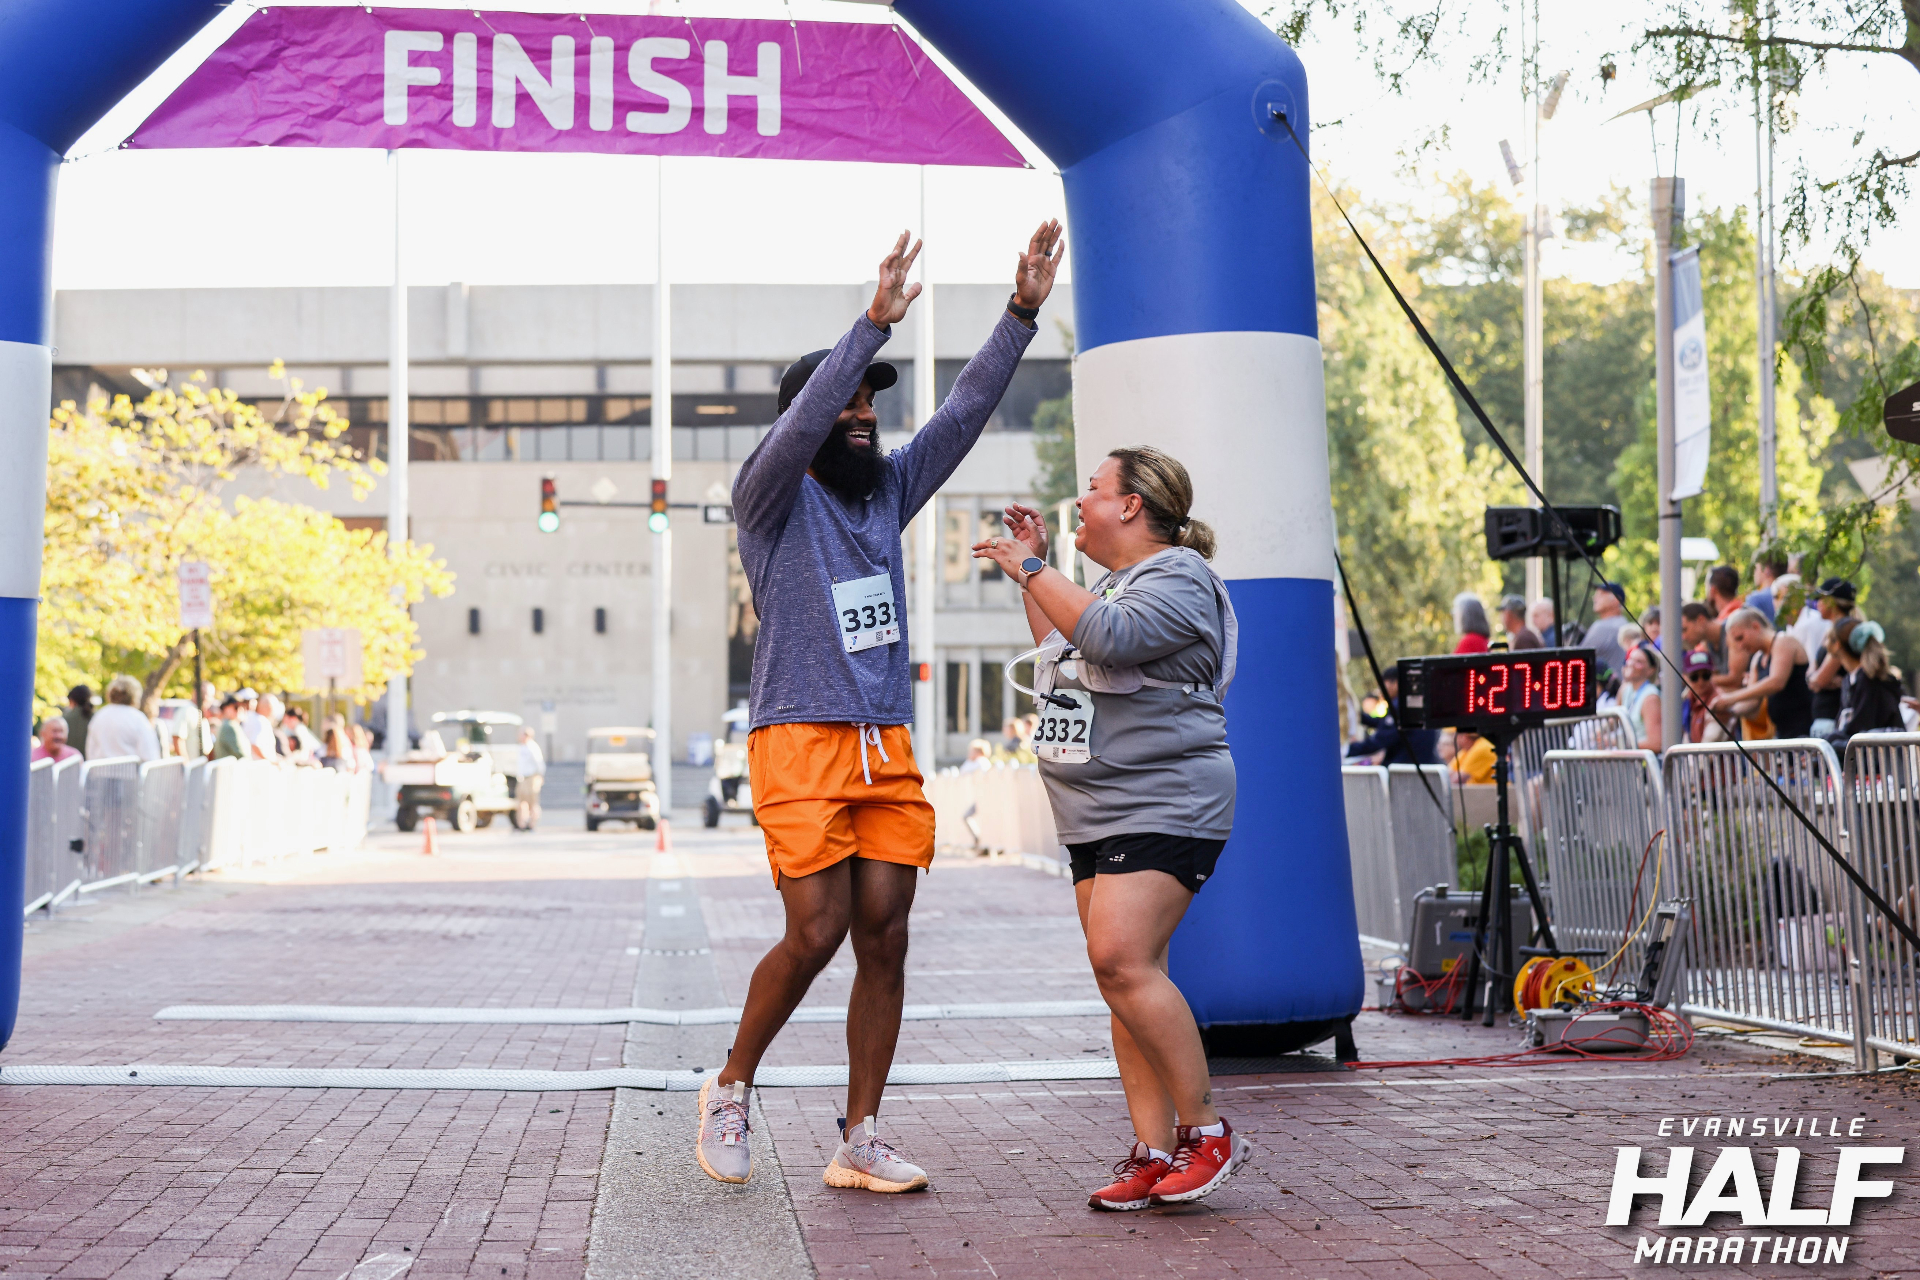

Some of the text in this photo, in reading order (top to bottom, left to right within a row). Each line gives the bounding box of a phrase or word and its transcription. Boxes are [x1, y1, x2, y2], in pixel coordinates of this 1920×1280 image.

[383, 30, 782, 136] FINISH
[484, 560, 652, 577] CIVIC CENTER
[842, 601, 898, 633] 333
[1033, 717, 1088, 744] 3332
